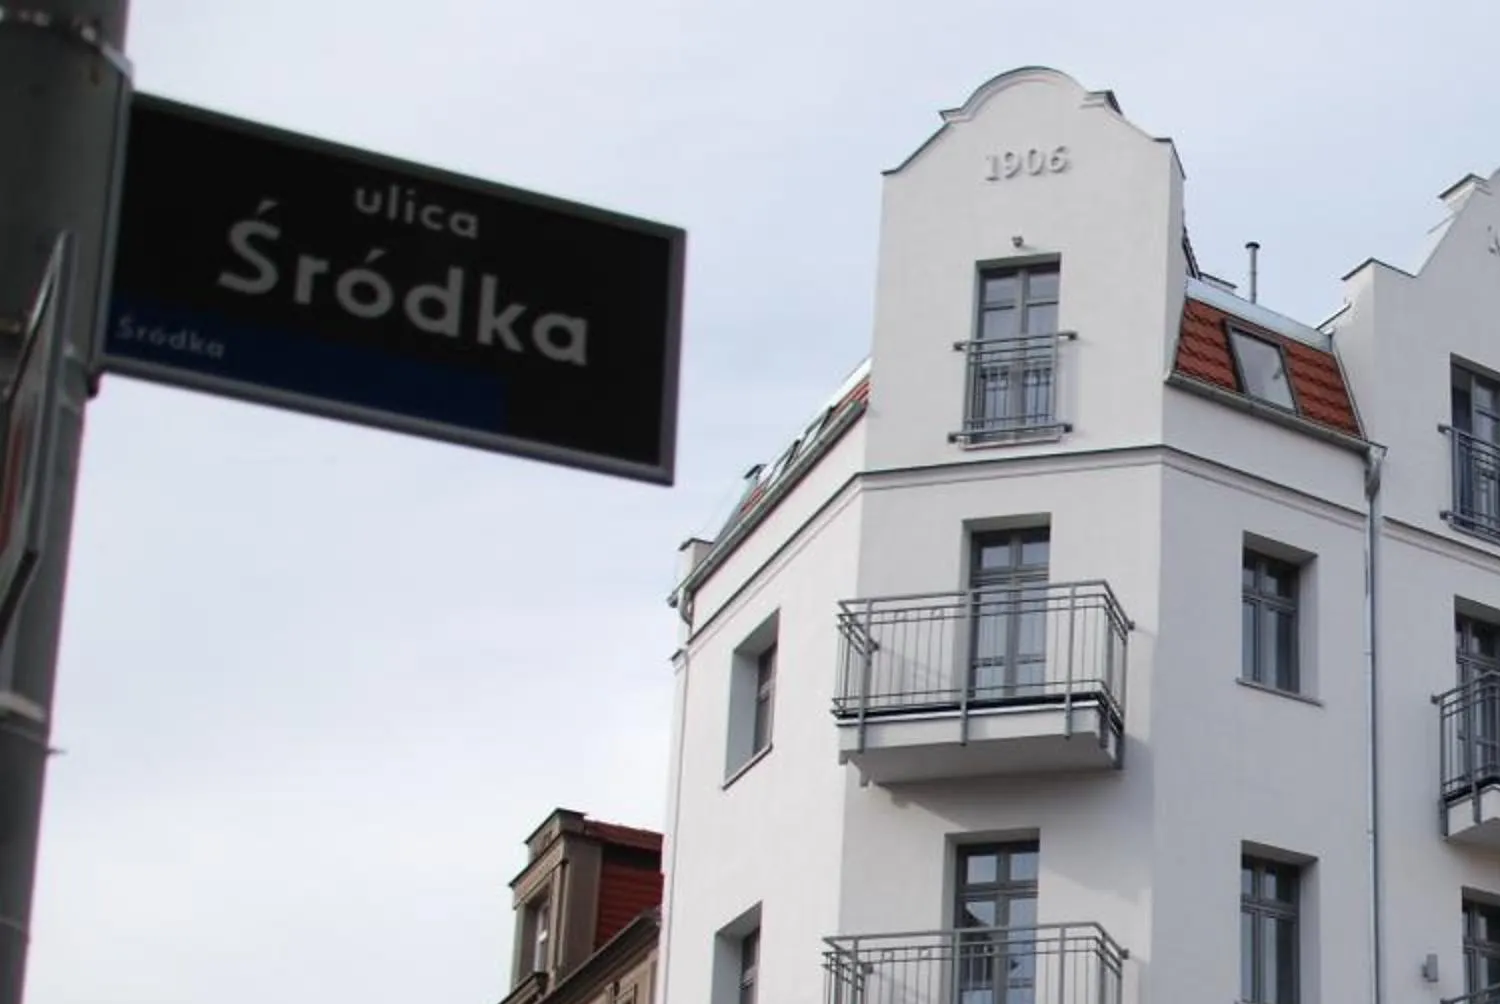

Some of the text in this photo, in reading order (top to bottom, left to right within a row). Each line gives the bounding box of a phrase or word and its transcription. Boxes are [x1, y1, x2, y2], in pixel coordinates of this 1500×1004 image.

[984, 145, 1073, 182] 1906
[354, 184, 480, 240] ulica
[217, 197, 588, 367] Śródka
[114, 310, 226, 360] Śródka
